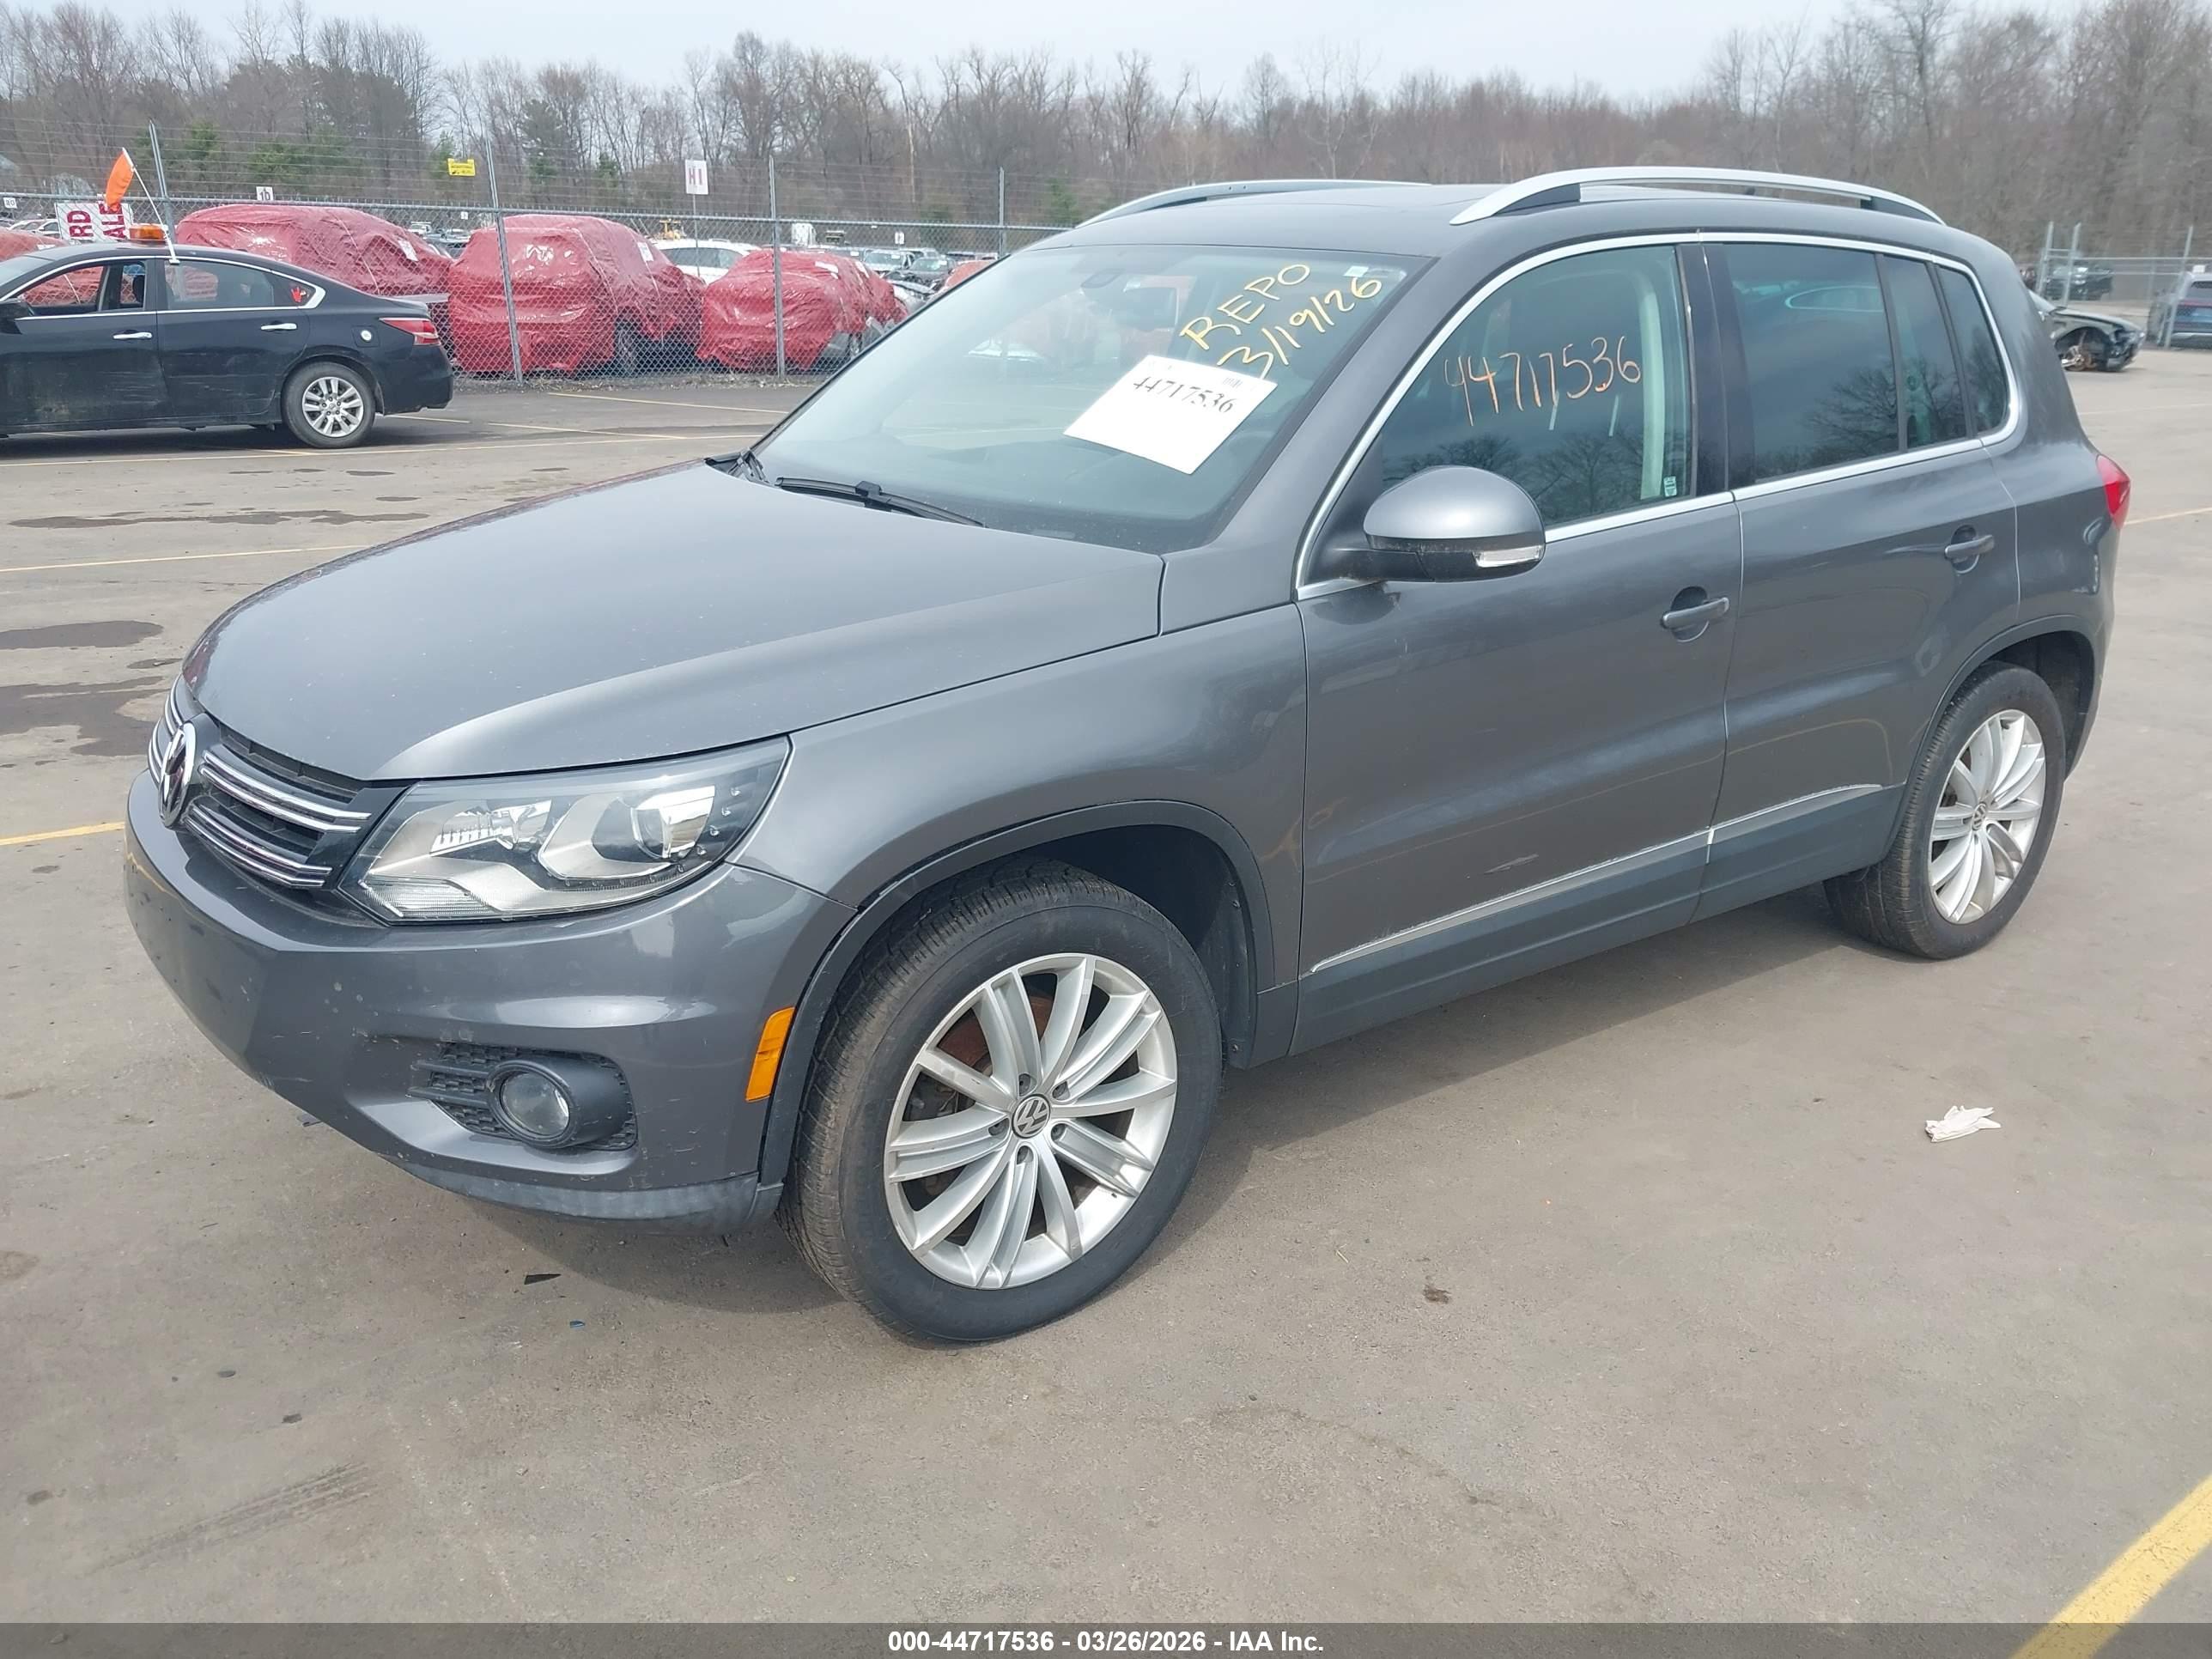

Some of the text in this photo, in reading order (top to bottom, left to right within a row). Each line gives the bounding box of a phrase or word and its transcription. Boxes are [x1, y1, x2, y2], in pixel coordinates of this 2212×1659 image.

[1180, 264, 1310, 350] REPO
[1217, 276, 1382, 380] 3/19/26
[1133, 376, 1237, 413] 44717536
